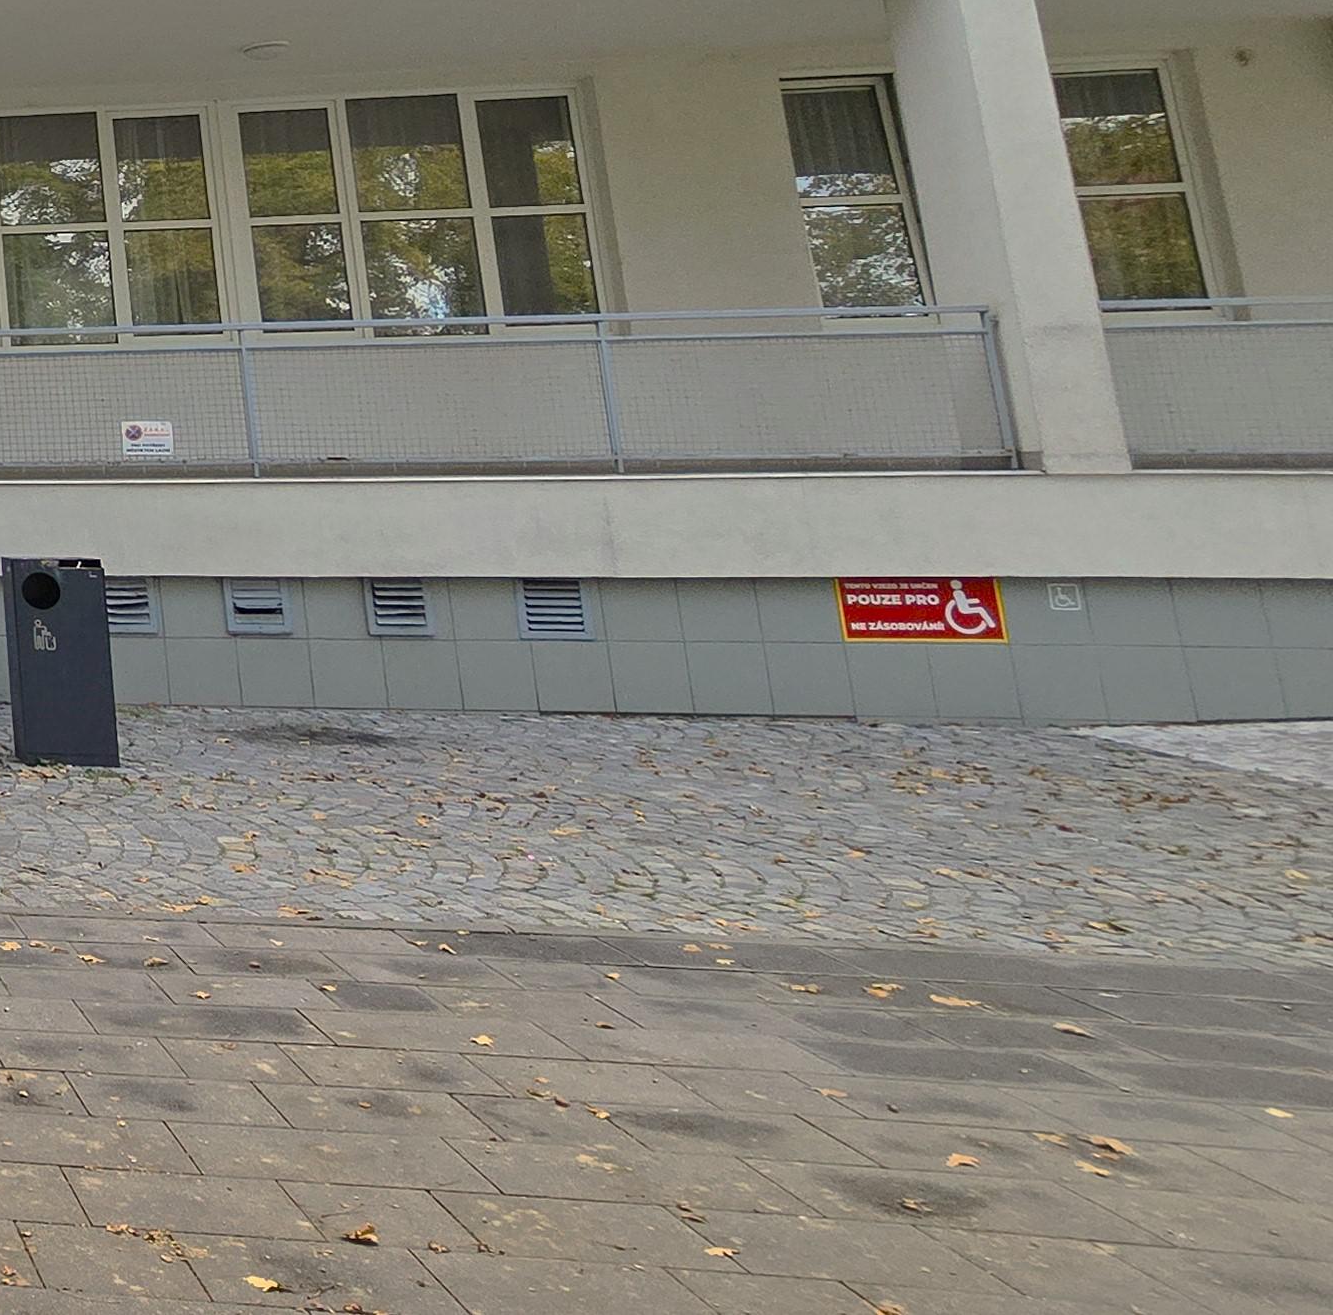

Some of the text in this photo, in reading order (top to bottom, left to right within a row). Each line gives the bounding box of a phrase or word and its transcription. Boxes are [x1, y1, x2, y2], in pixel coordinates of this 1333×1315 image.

[846, 594, 940, 605] POUZE PRO
[851, 622, 867, 631] NE
